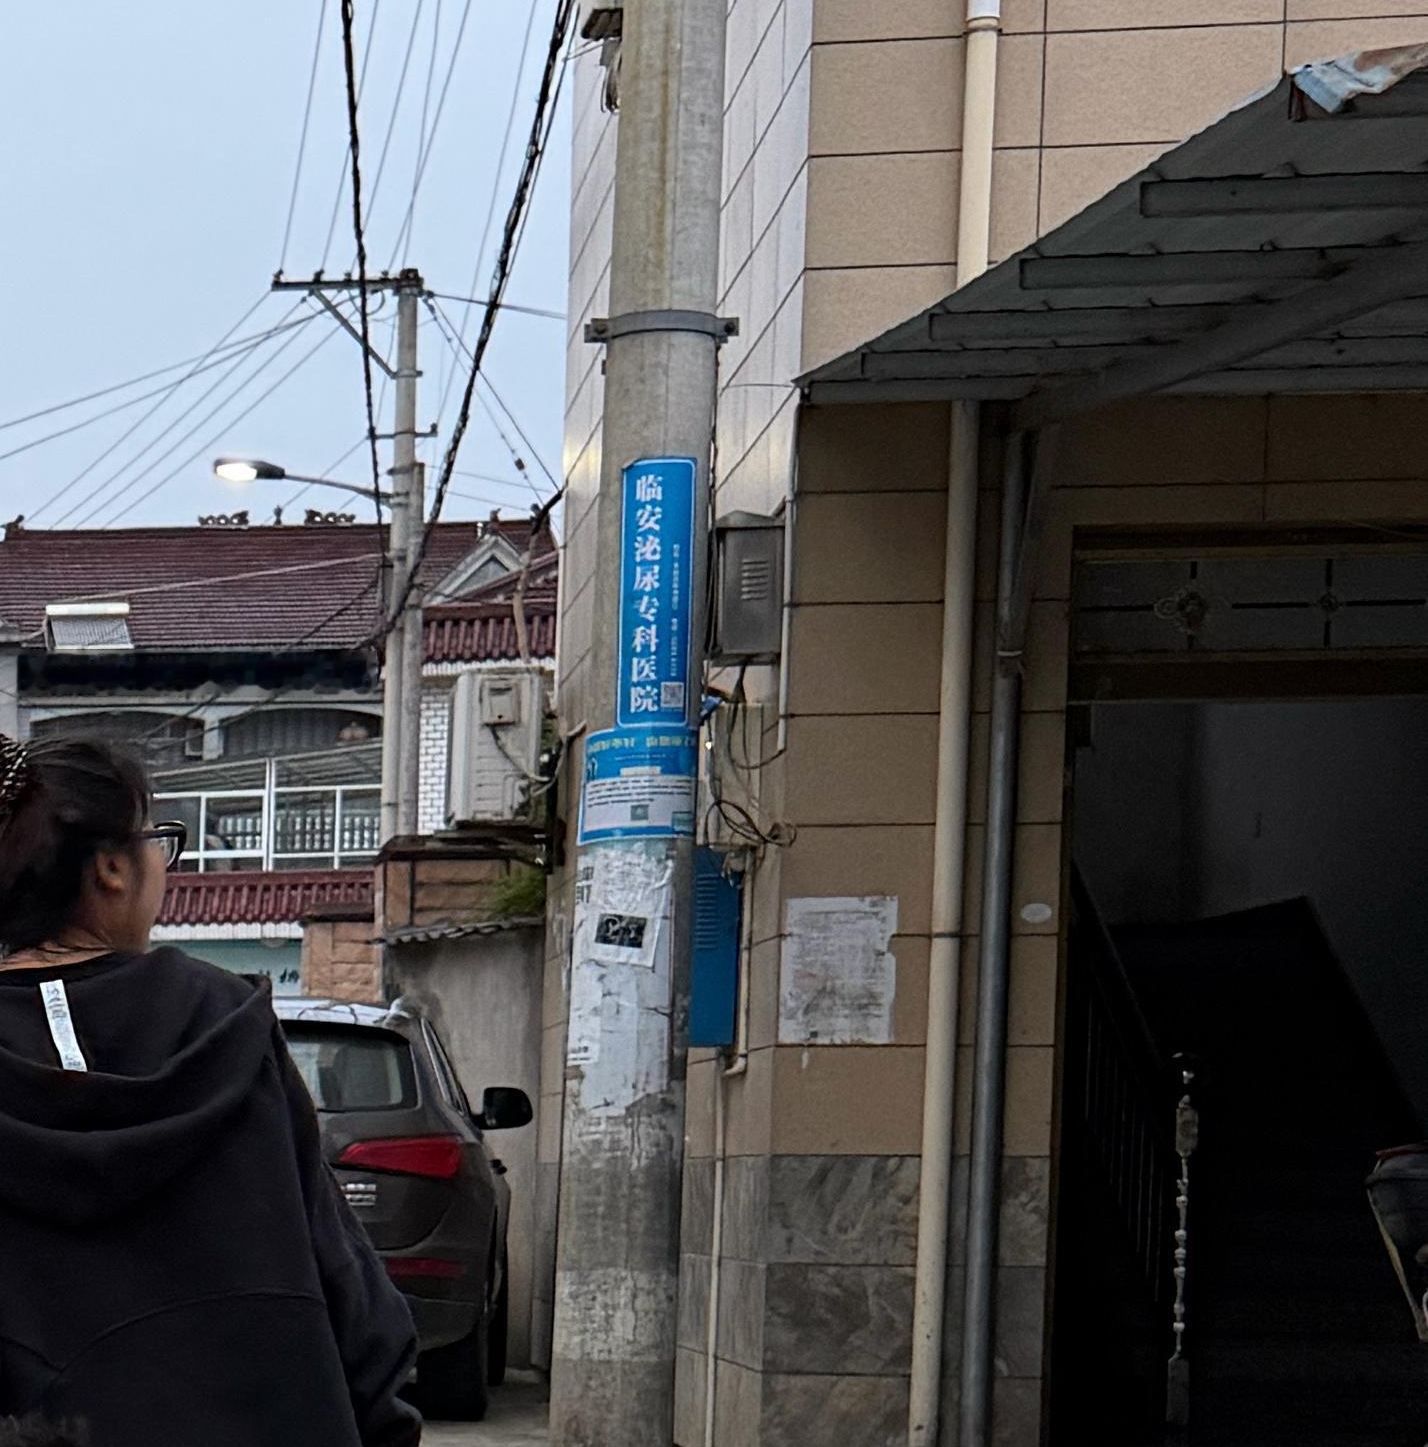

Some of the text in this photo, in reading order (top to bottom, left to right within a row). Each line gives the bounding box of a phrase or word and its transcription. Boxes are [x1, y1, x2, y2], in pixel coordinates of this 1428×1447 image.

[630, 474, 663, 714] 临安泌尿专科医院
